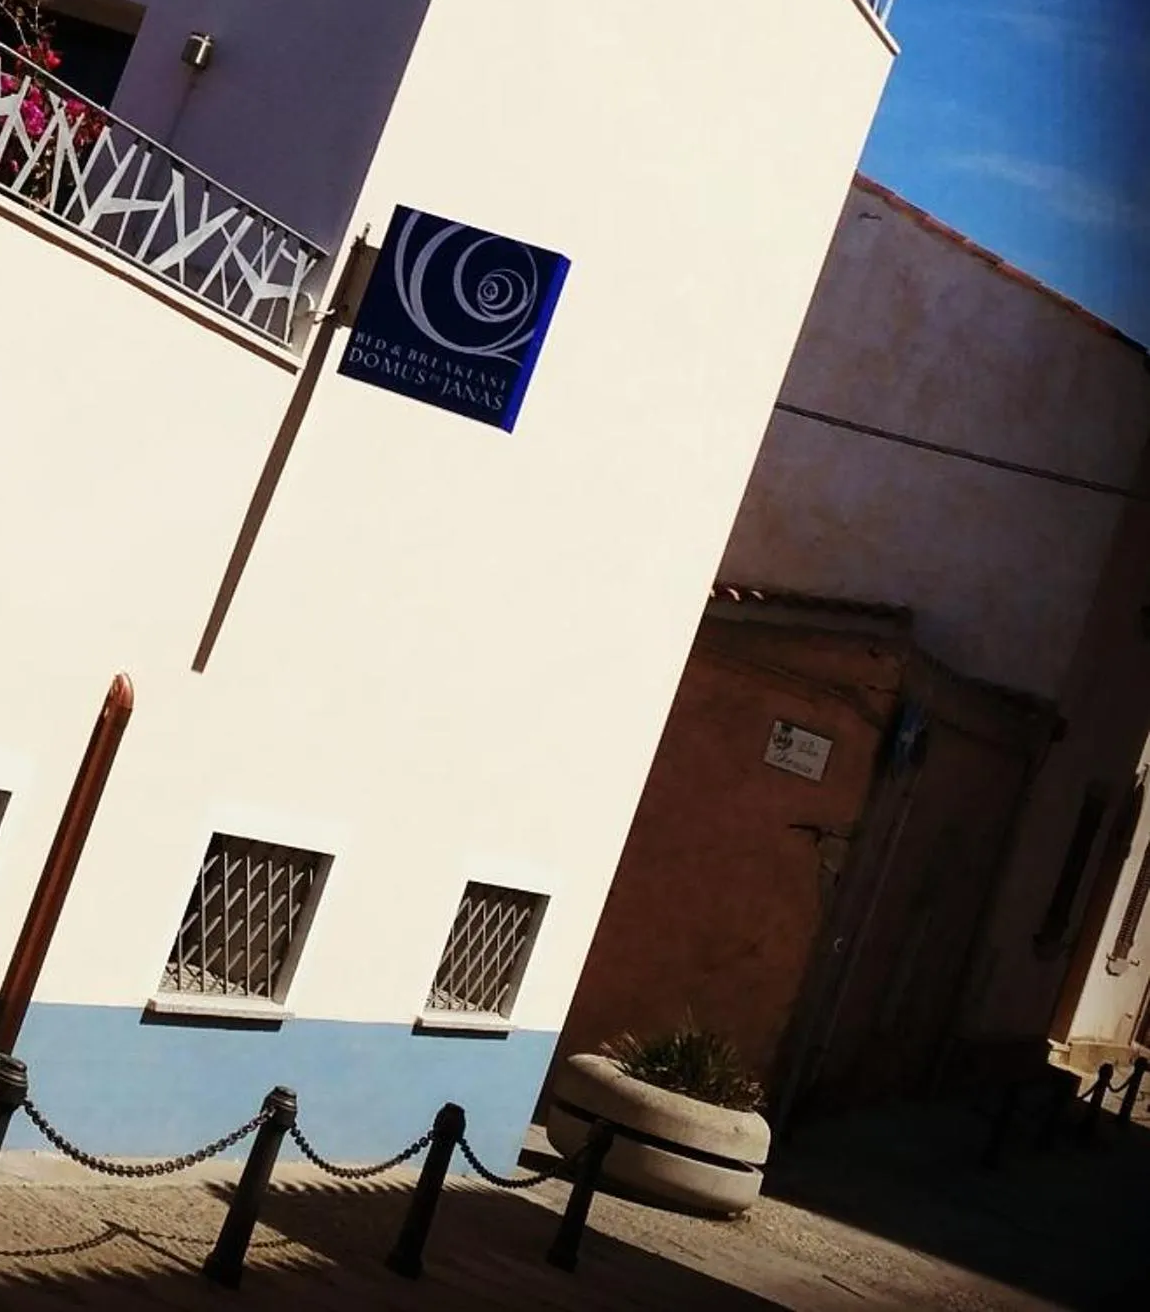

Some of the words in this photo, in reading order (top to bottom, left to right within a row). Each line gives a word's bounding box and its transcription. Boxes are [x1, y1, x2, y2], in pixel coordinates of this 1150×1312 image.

[348, 347, 426, 385] DOMUS
[441, 376, 503, 410] JANAS
[354, 332, 386, 350] BED
[408, 348, 507, 391] BREAKFAST
